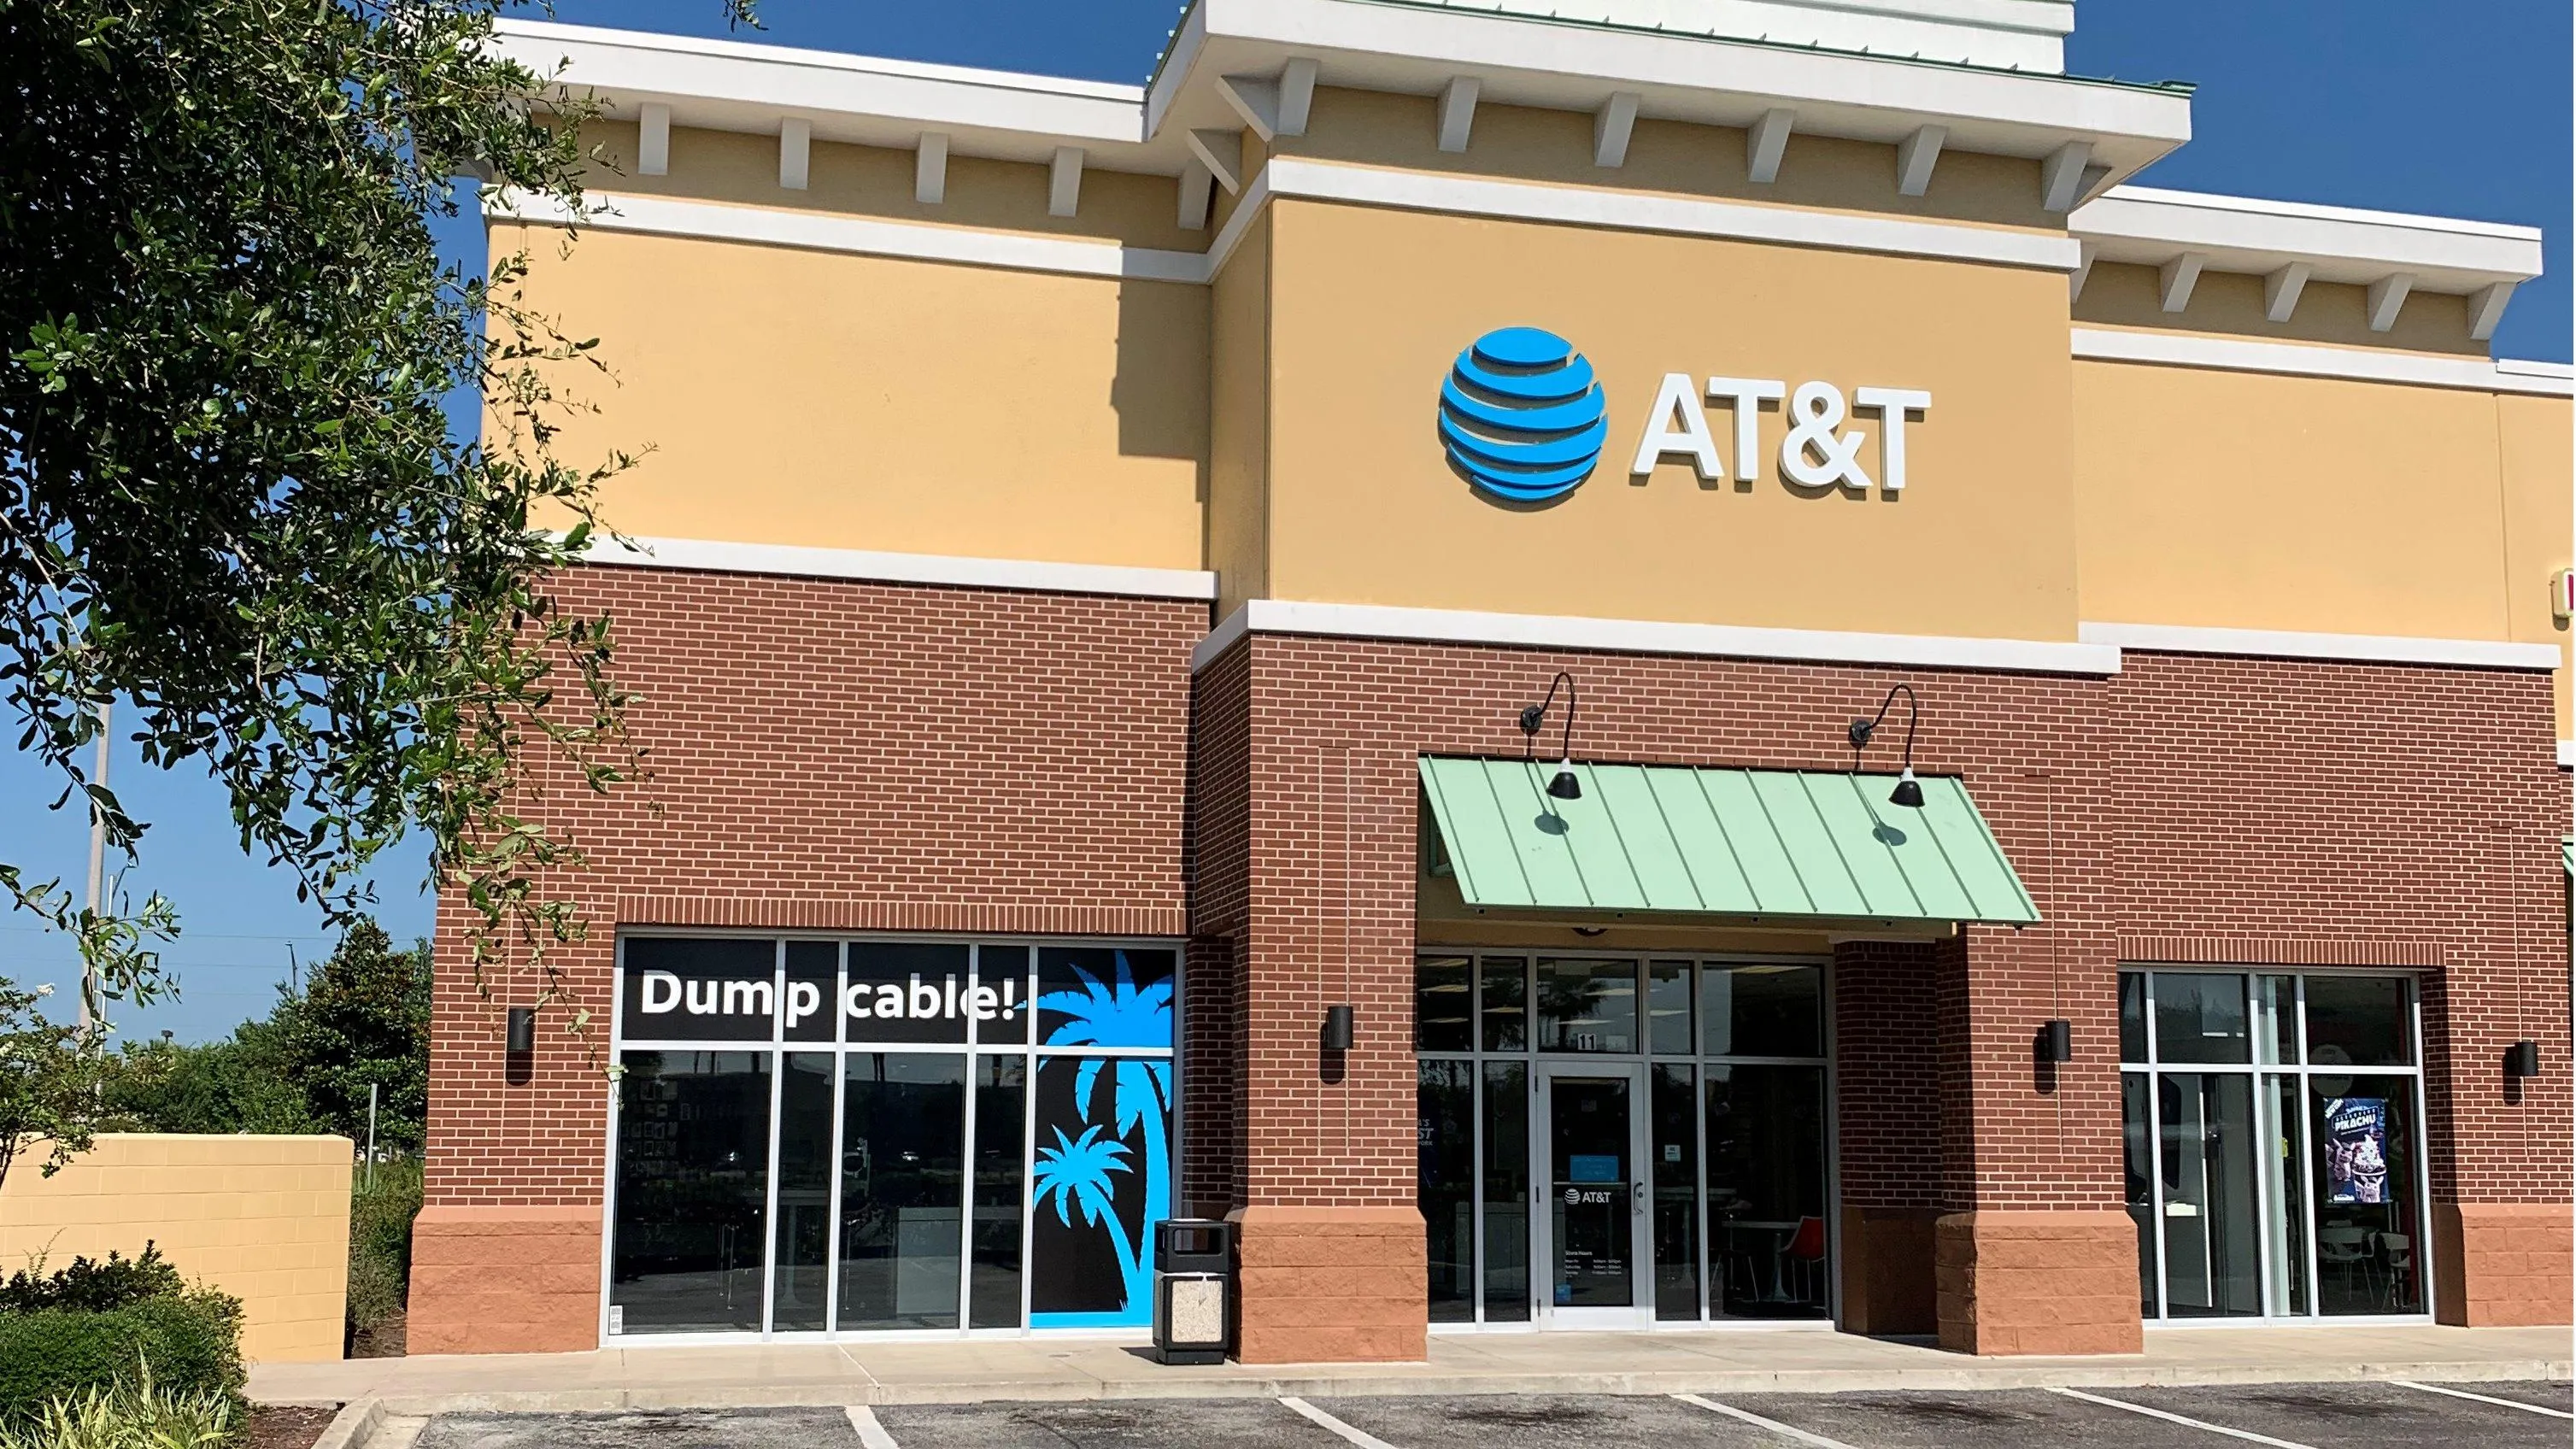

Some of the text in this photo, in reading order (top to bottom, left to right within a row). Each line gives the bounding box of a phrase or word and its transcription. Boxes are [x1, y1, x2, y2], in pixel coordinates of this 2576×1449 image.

[1631, 373, 1932, 490] AT&T
[640, 969, 1015, 1029] Dump cable!
[1580, 1034, 1595, 1049] 11
[2334, 1113, 2376, 1132] PIKACHU
[1581, 1191, 1612, 1204] AT&T
